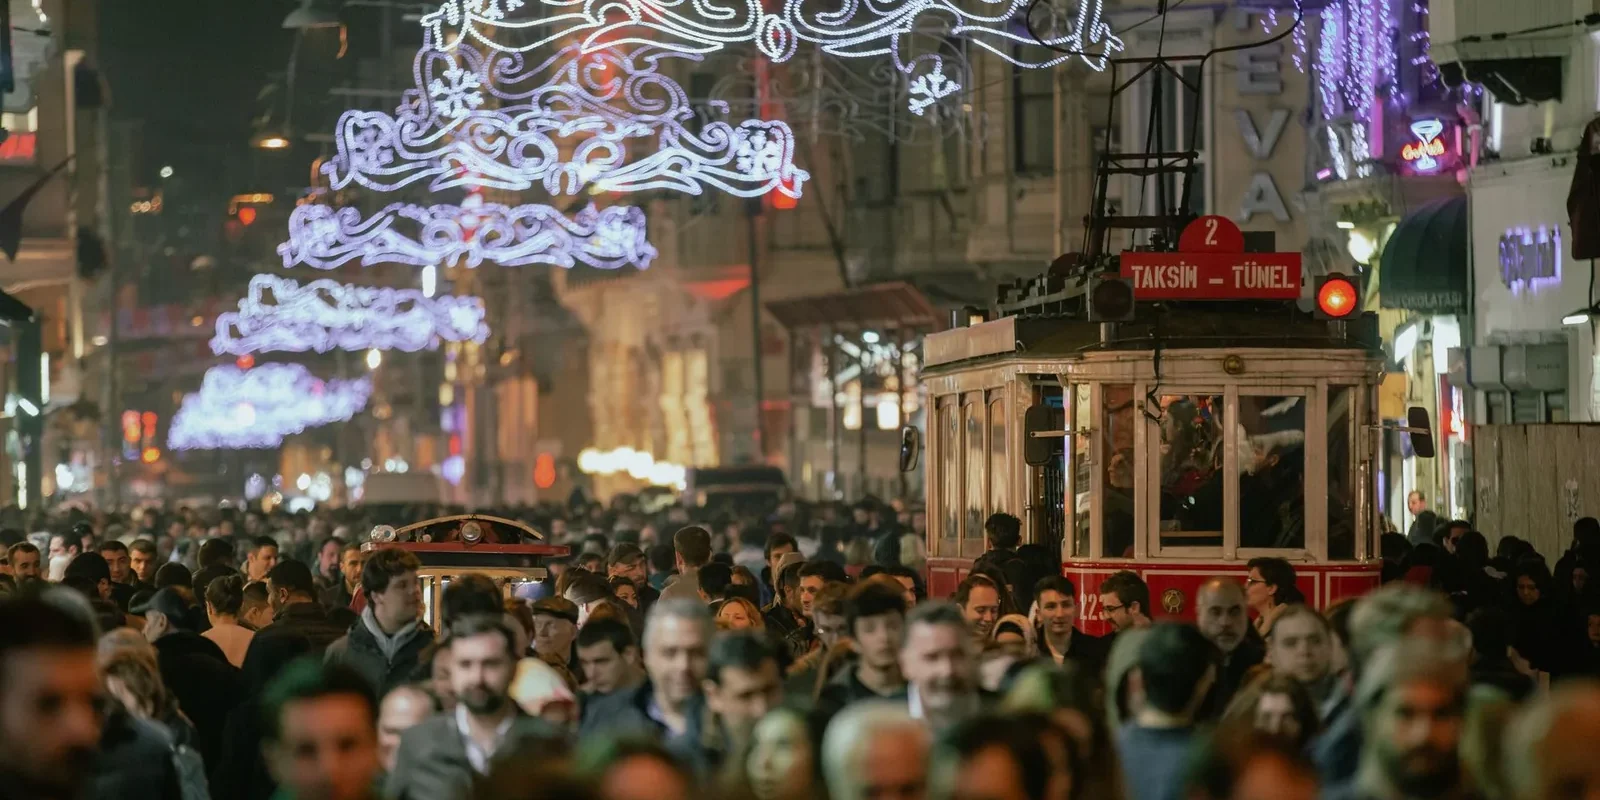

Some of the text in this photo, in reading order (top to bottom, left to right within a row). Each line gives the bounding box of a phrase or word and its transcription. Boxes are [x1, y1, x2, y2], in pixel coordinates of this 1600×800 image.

[1205, 219, 1218, 245] 2
[1131, 261, 1197, 288] TAKSİM
[1232, 261, 1295, 288] TÜNEL
[1080, 593, 1103, 620] 22
